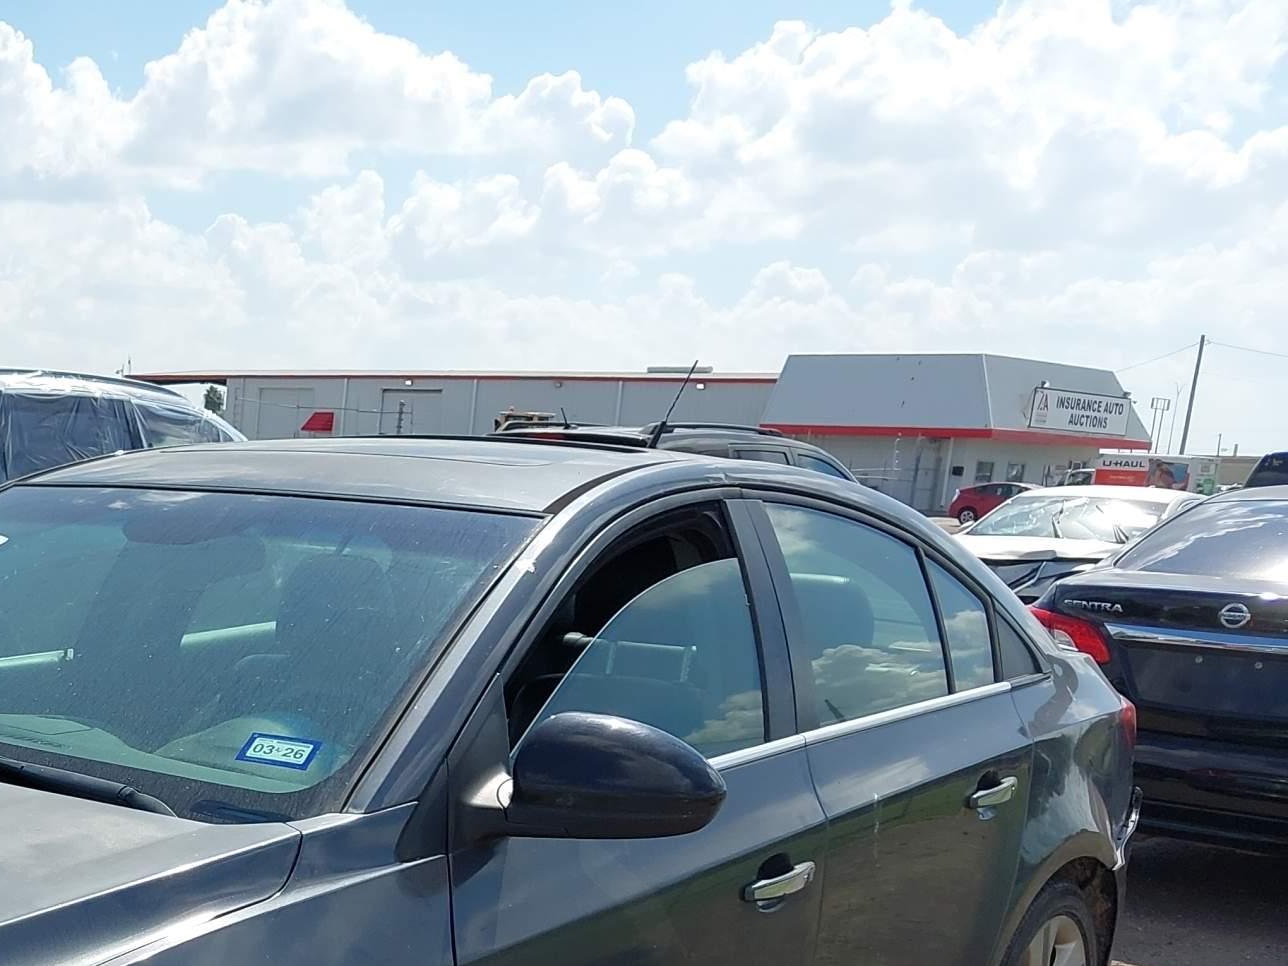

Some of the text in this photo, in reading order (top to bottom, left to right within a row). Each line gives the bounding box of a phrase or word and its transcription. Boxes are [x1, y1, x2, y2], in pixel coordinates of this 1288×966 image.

[1056, 396, 1124, 415] INSURANCE AUTO
[1068, 414, 1108, 428] AUCTIONS
[1102, 460, 1145, 468] U-HAUL
[1063, 599, 1124, 613] SENTRA
[252, 743, 306, 759] 03 26
